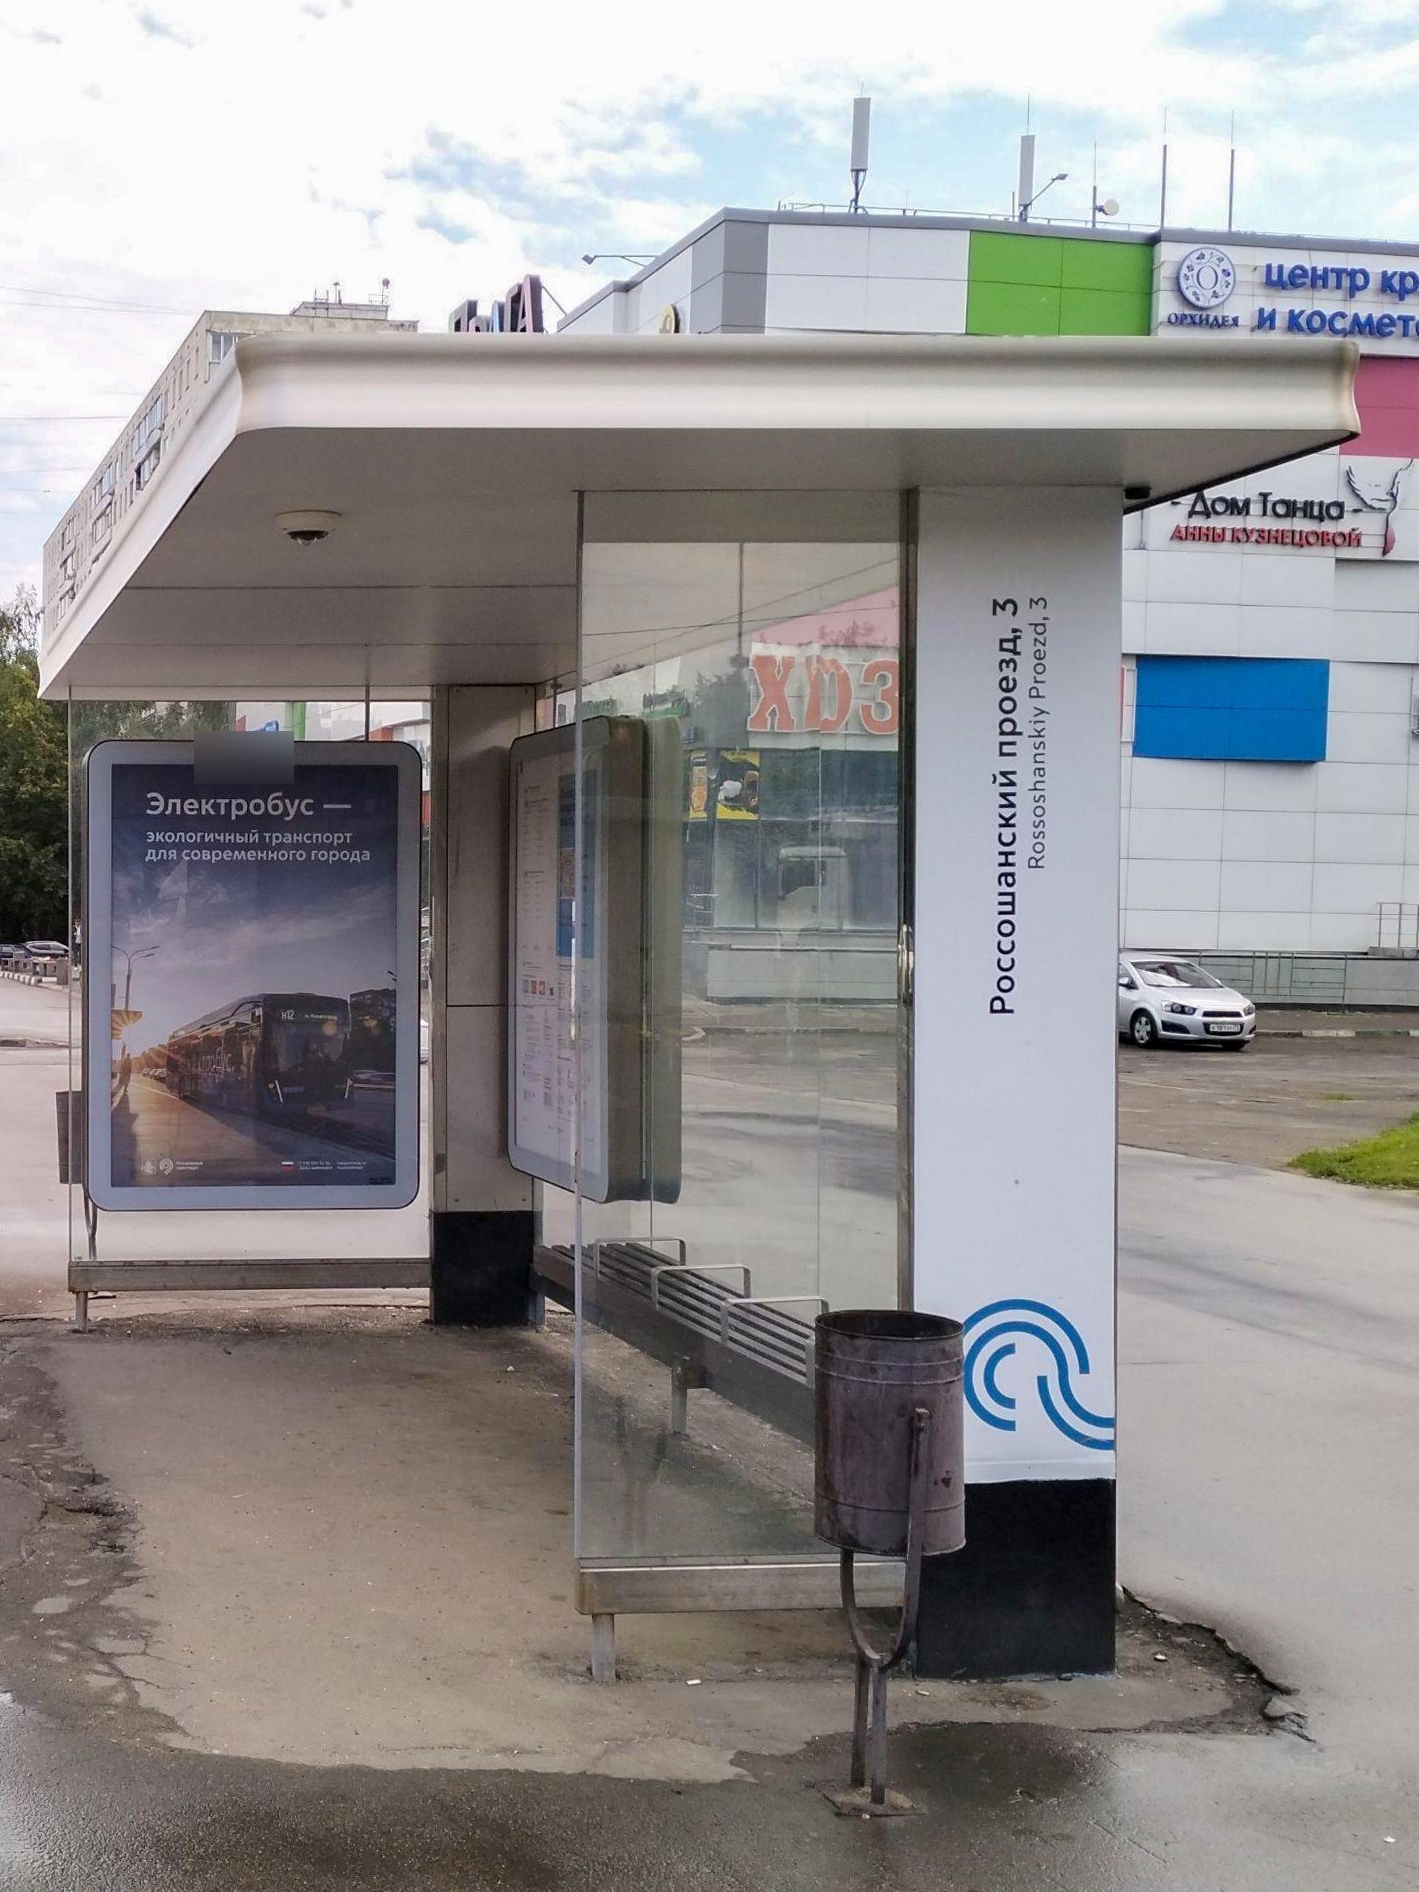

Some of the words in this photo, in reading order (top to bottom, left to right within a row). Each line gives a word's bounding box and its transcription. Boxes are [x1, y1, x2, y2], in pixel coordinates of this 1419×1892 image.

[1264, 262, 1371, 299] центр
[1167, 312, 1240, 329] ОРХИДЕЯ
[1257, 307, 1277, 331] и
[1287, 308, 1419, 338] космет
[1188, 491, 1251, 519] Дом
[1258, 491, 1346, 523] Танца
[1169, 523, 1227, 543] АННЫ
[1230, 527, 1363, 549] КУЗНЕЦОВОЙ
[992, 598, 1018, 617] 3
[1028, 596, 1048, 611] 3
[1027, 616, 1051, 699] Proezd,
[997, 627, 1023, 758] проезд,
[1027, 706, 1051, 869] Rossoshanskiy
[145, 791, 315, 821] Электробус
[145, 829, 259, 844] экологичный
[263, 831, 353, 846] транспорт
[145, 849, 178, 862] для
[181, 849, 307, 863] современного
[311, 850, 370, 864] города
[989, 770, 1018, 1015] Россошанский
